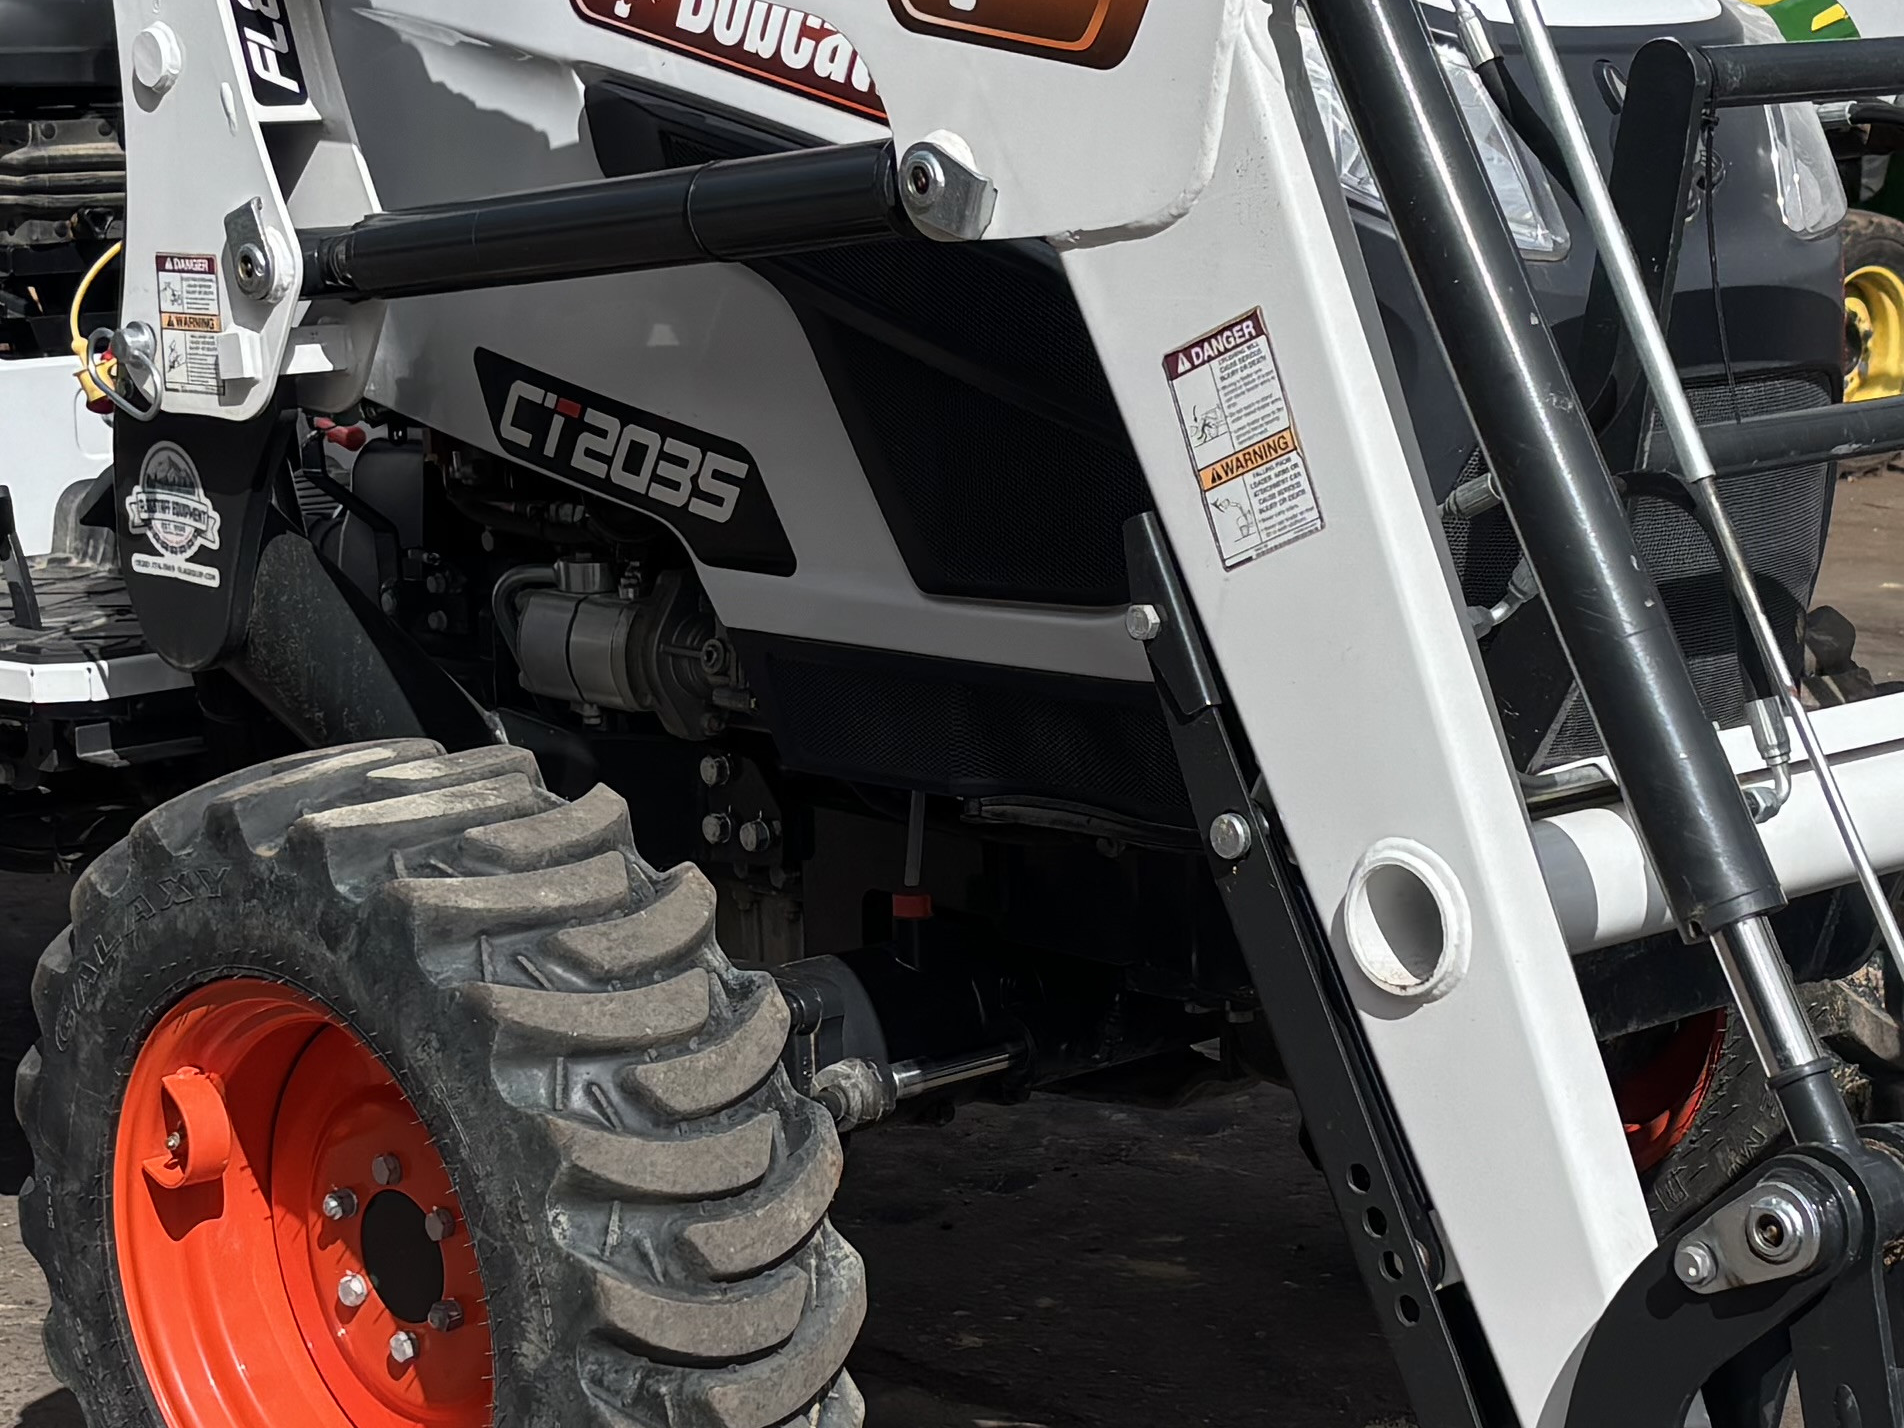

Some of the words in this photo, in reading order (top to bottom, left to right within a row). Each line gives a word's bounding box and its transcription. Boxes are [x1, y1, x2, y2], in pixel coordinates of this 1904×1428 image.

[173, 258, 209, 272] DANGER
[176, 316, 215, 330] WARNING
[1191, 320, 1256, 366] DANGER
[500, 380, 749, 523] CT2035
[1222, 435, 1289, 477] WARNING
[54, 865, 232, 1052] GALAXY
